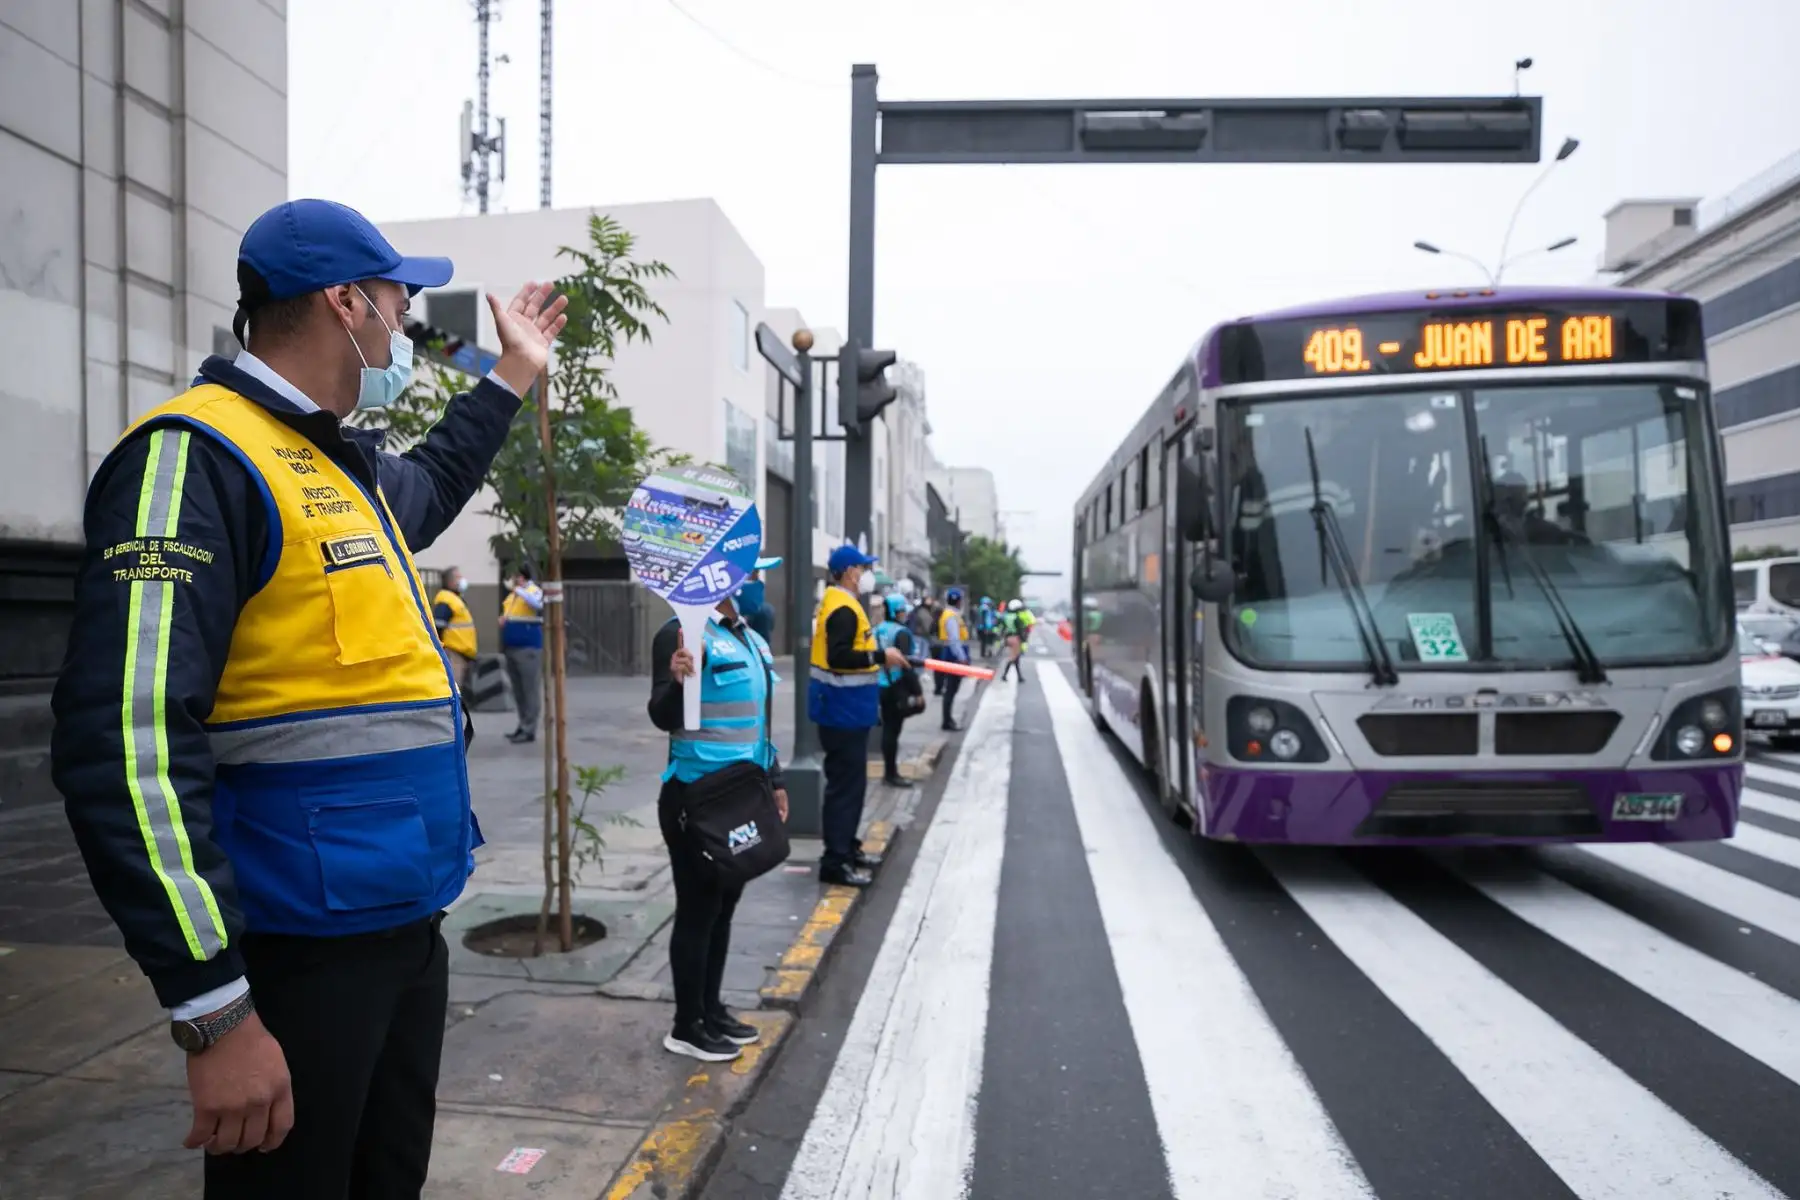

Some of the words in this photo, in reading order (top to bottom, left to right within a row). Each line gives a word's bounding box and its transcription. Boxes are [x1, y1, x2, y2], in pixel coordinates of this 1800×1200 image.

[1304, 328, 1371, 372] 409.
[1414, 321, 1493, 368] JUAN
[1506, 318, 1548, 363] DE
[1562, 315, 1612, 360] ARI
[115, 540, 146, 555] GERENCIA
[149, 540, 160, 552] DE
[163, 541, 214, 565] FISCALIZACION
[139, 553, 167, 565] DEL
[113, 566, 194, 584] TRANSPORTE
[699, 560, 732, 593] 15
[1422, 639, 1461, 656] 32
[728, 820, 758, 848] ATU
